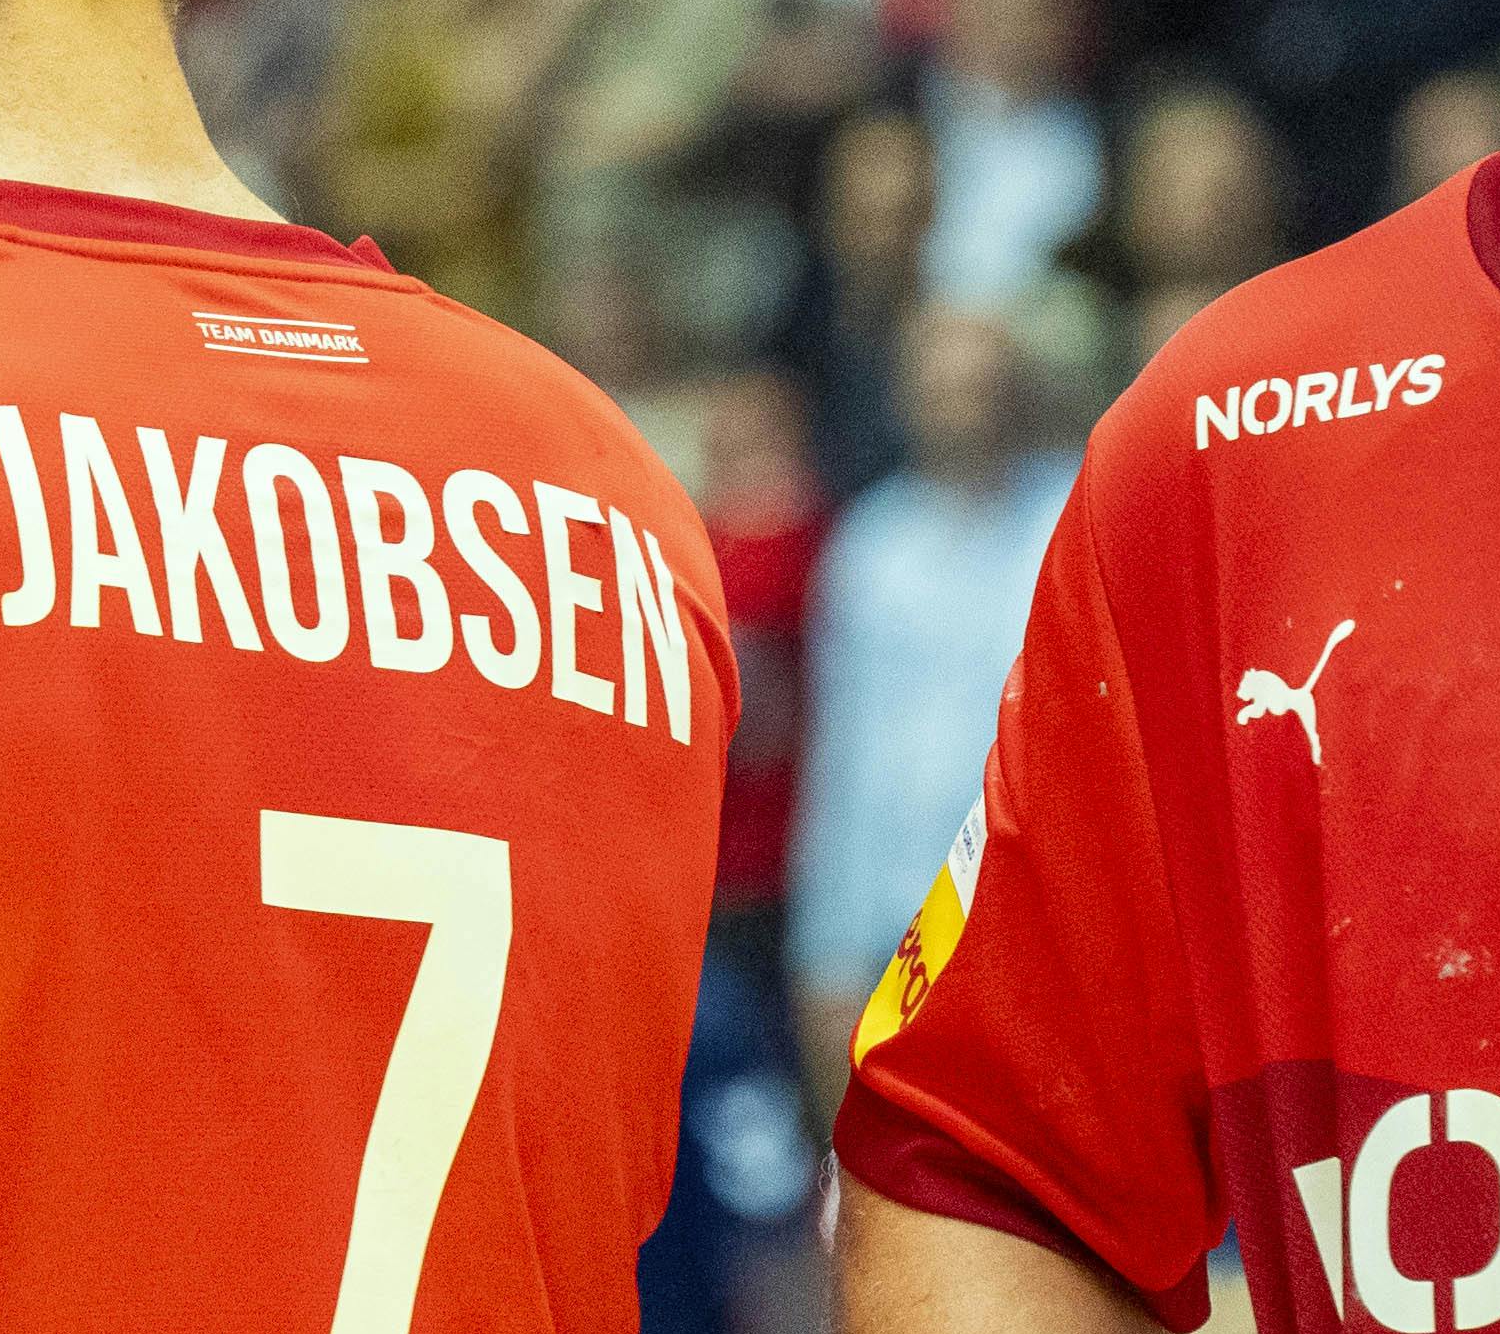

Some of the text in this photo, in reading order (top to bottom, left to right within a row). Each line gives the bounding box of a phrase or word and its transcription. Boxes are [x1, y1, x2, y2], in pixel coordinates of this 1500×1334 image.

[195, 322, 365, 352] TEAM DANMARK
[1195, 353, 1446, 451] NORLYS
